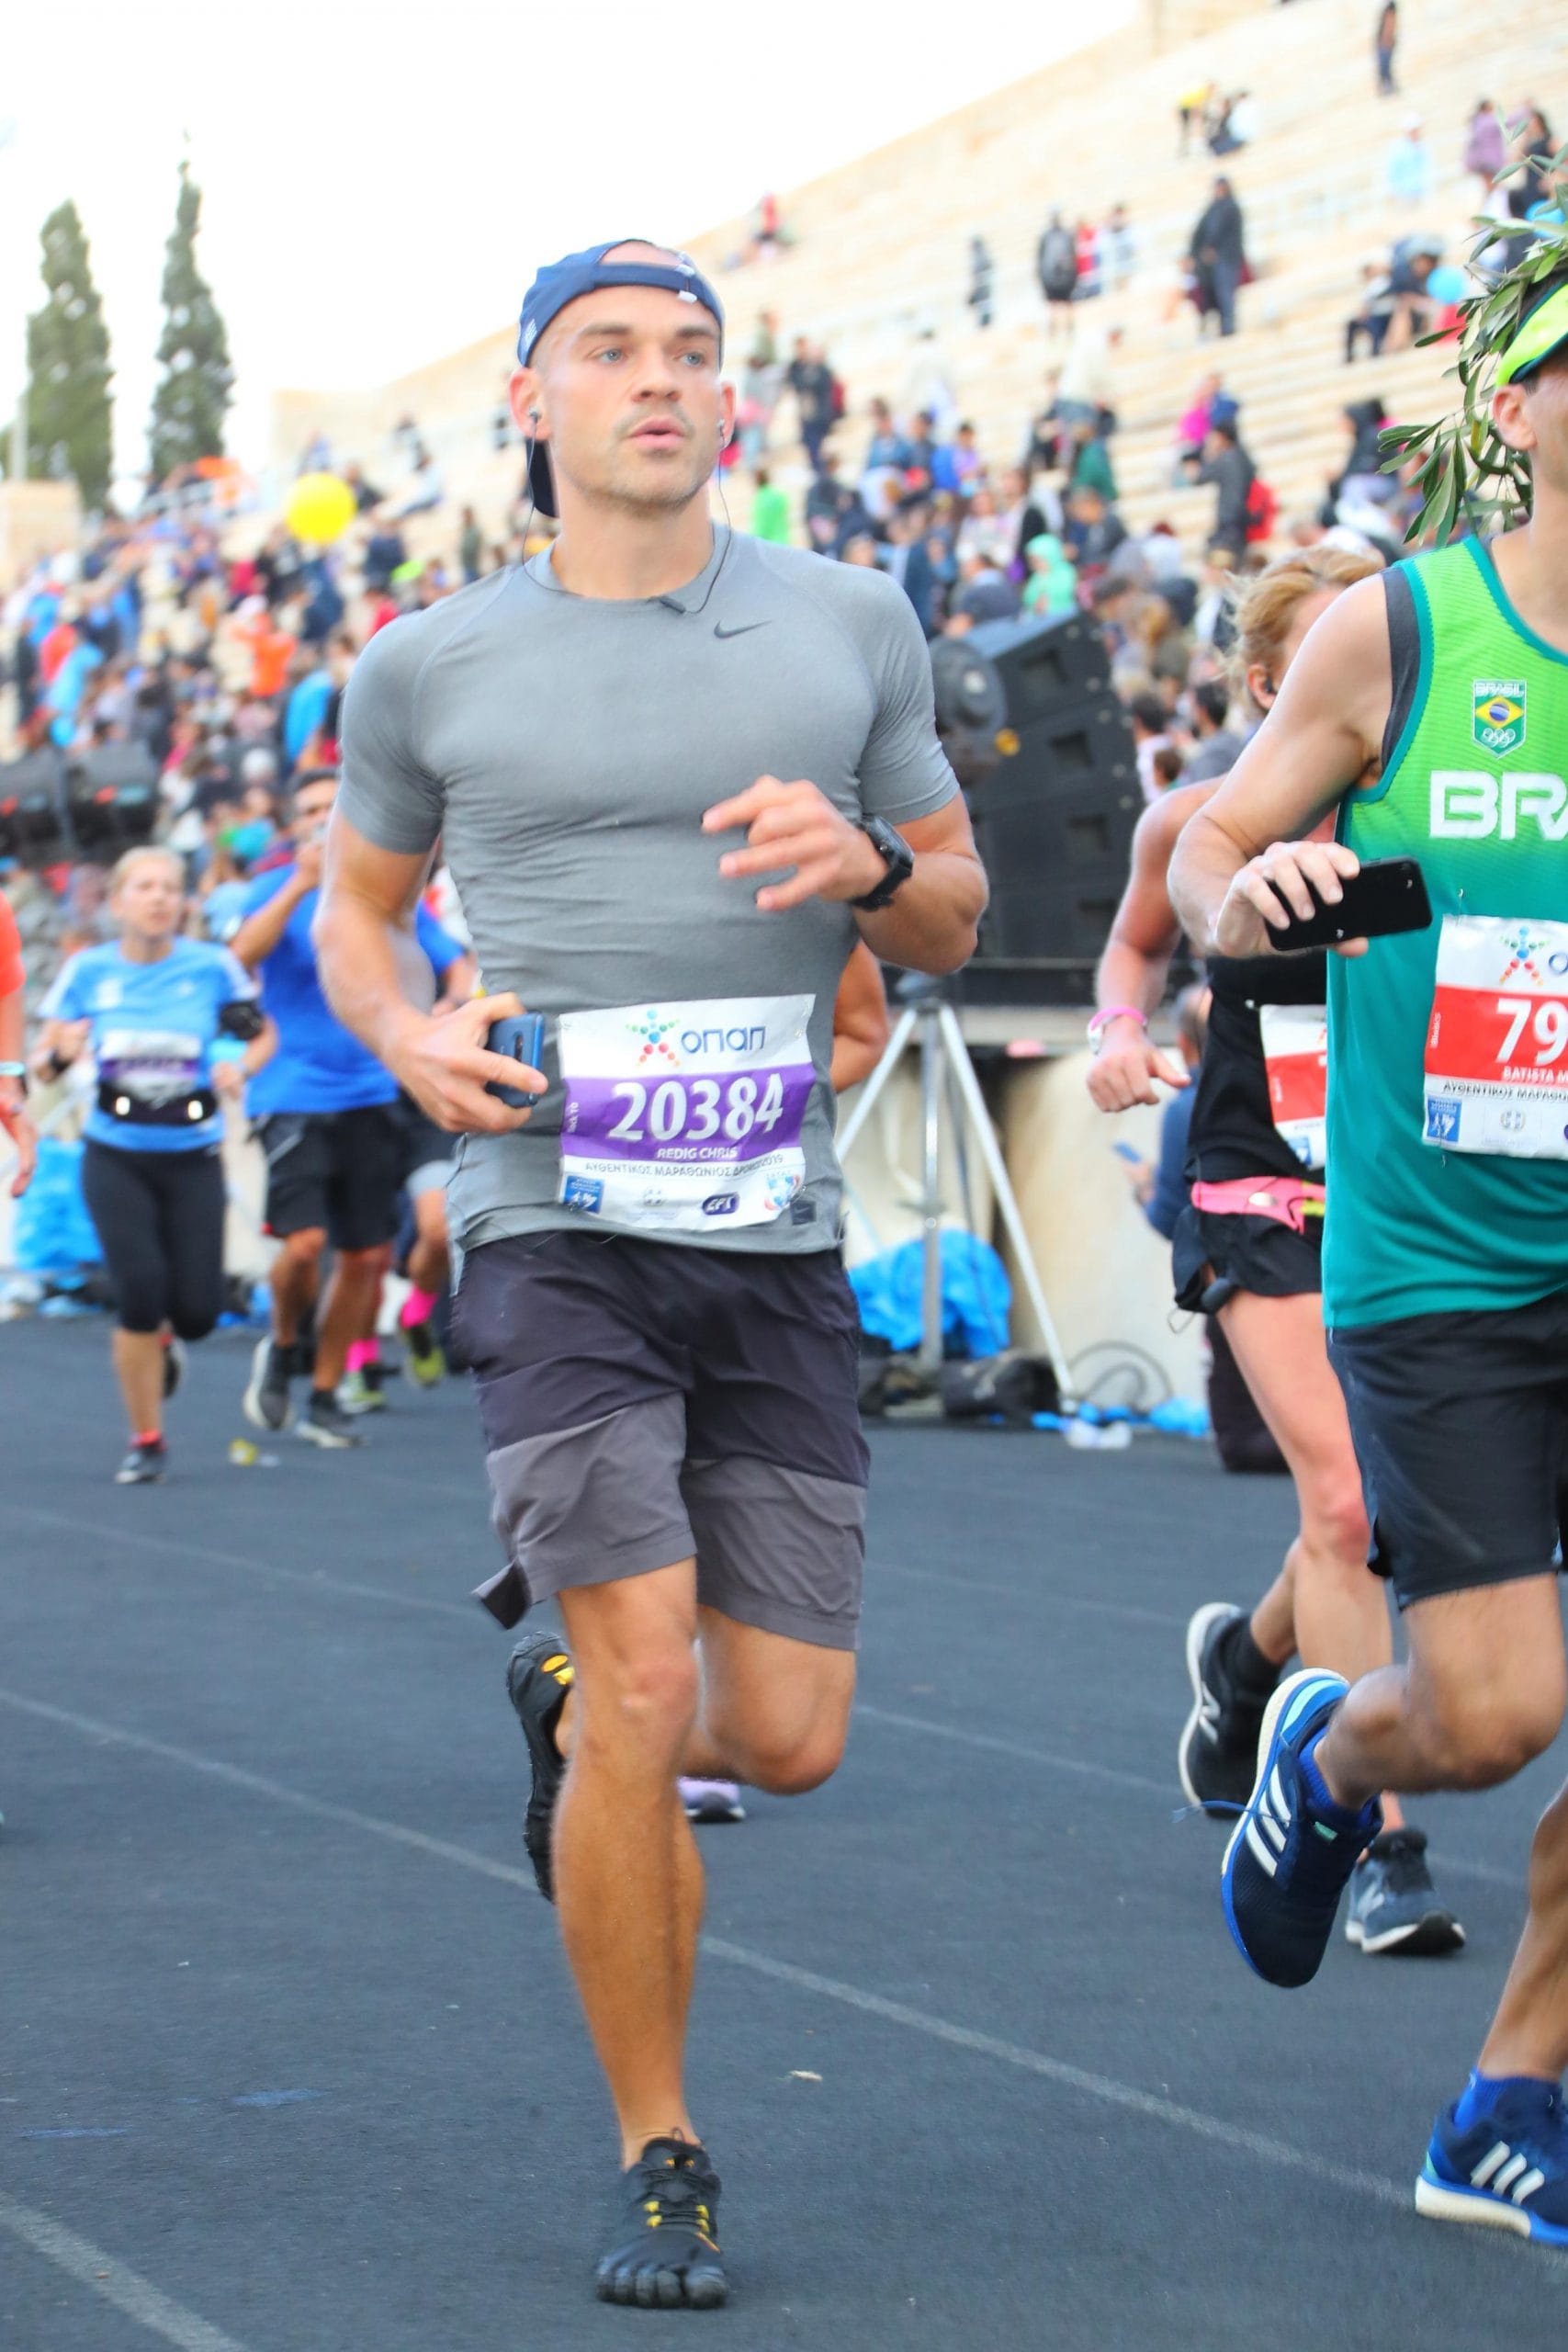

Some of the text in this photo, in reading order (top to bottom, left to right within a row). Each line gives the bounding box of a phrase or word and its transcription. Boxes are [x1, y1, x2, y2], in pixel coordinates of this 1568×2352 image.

[1502, 1067, 1554, 1083] BATISTA
[607, 1073, 784, 1141] 20384
[657, 1147, 739, 1159] REDIG CHRIS
